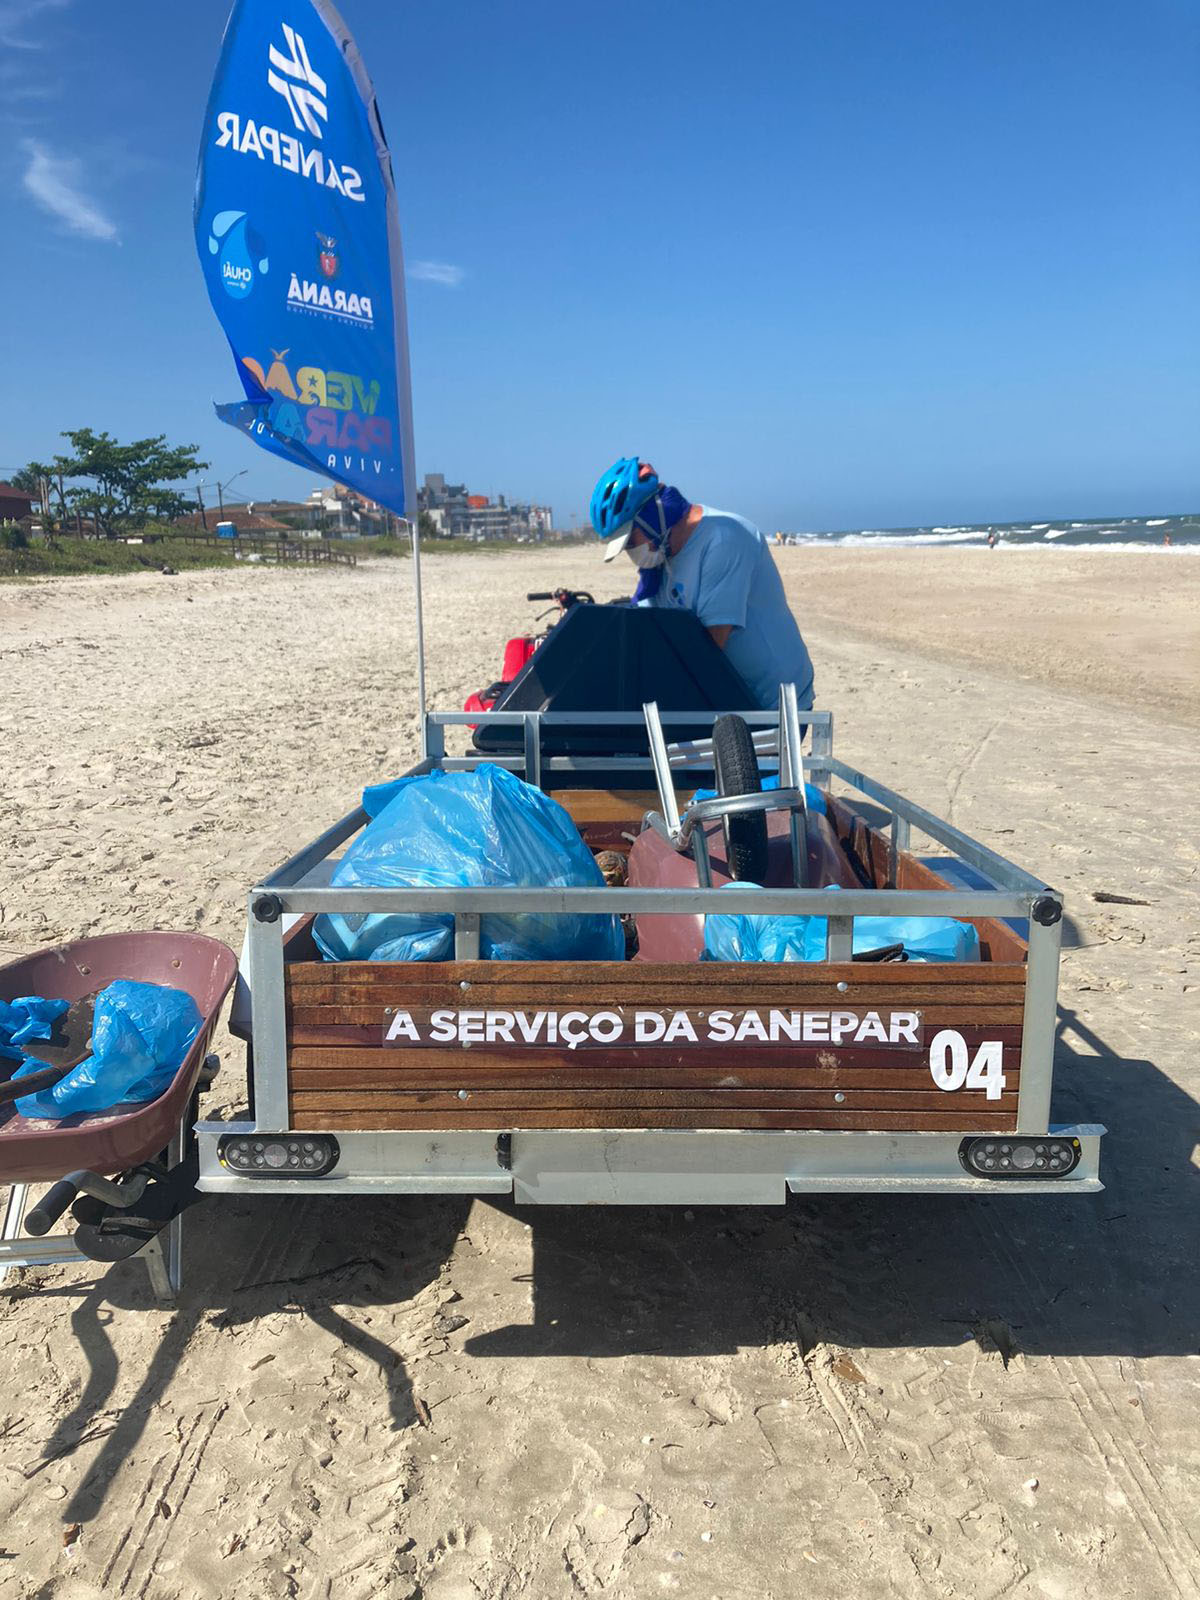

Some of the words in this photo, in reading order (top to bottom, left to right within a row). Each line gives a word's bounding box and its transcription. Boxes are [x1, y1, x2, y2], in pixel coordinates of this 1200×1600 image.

[385, 1010, 421, 1041] A
[429, 1010, 624, 1050] SERVIÇO
[635, 1010, 699, 1042] DA
[707, 1009, 920, 1043] SANEPAR
[929, 1029, 1006, 1101] 04
